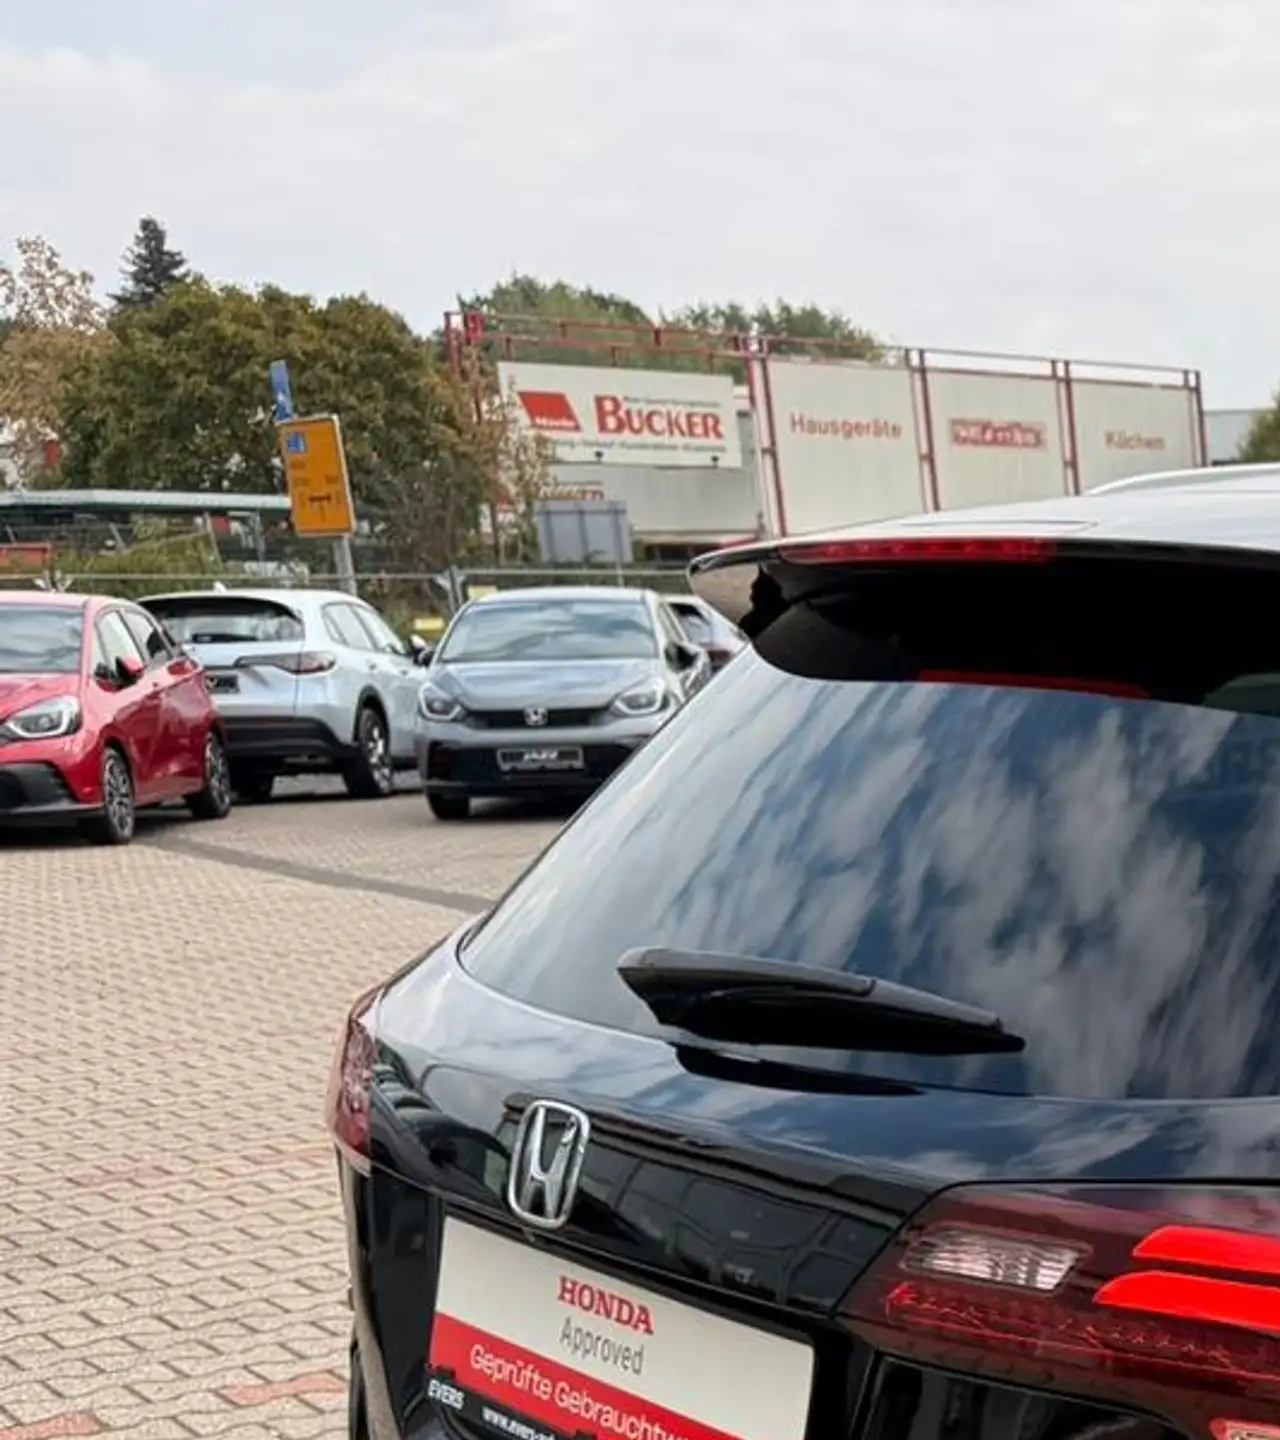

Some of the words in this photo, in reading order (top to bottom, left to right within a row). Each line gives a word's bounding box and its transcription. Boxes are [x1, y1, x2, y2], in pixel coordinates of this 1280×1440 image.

[790, 413, 902, 439] Hausgeräte
[1104, 430, 1166, 451] Küchen
[557, 1276, 654, 1336] HONDA
[560, 1316, 645, 1376] Approved
[427, 1379, 465, 1410] EVERS
[469, 1344, 553, 1401] Geprüfte
